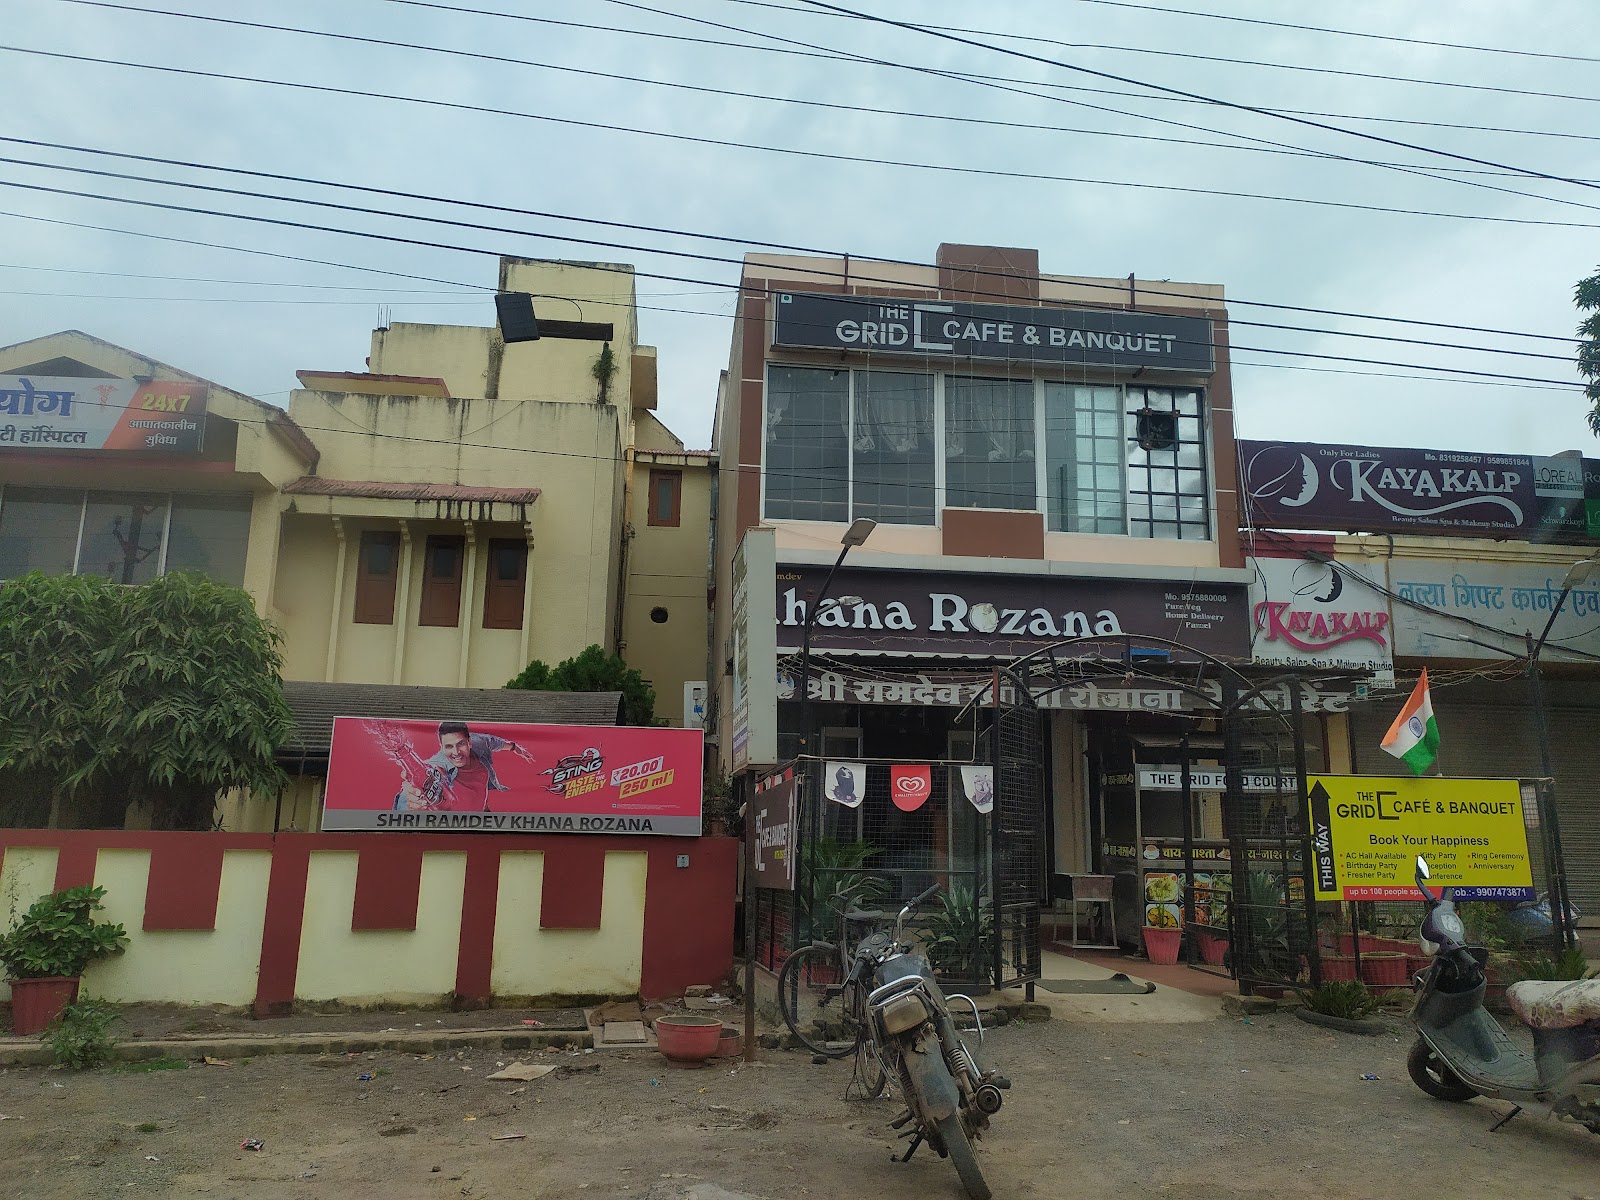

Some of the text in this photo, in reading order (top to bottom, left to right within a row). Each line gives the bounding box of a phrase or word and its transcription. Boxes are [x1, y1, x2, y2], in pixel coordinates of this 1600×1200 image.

[879, 304, 909, 320] THE
[836, 320, 909, 346] GRID
[1022, 325, 1041, 345] &
[1050, 327, 1177, 353] BANQUET
[142, 393, 191, 412] 24x7
[129, 419, 197, 431] आपातकालीन
[145, 433, 178, 447] सुविधा
[1320, 449, 1339, 458] Only
[1355, 451, 1381, 459] Ladies
[1330, 459, 1522, 508] KAYAKALP
[1392, 515, 1417, 524] Beauty
[1462, 520, 1491, 528] Makeup
[1165, 593, 1180, 601] Mo.
[777, 587, 917, 631] hana
[929, 593, 1126, 637] Rzana
[1186, 603, 1202, 612] Veg
[1191, 613, 1225, 622] Delivery
[1254, 602, 1390, 645] KAYAKALP
[1368, 661, 1393, 671] Studio
[853, 675, 962, 705] रामदेव
[553, 758, 603, 784] STING
[565, 774, 596, 790] TASTE
[622, 779, 649, 796] 250
[1150, 774, 1296, 788] THE RID FD COURT
[565, 779, 607, 799] ENERGY
[1357, 792, 1374, 801] THE
[1336, 799, 1515, 819] GRID CAFÉ & BANQUET
[376, 813, 654, 832] SHRI RAMDEV KHANA ROZANA
[1369, 834, 1489, 848] Book Your Happiness
[1317, 823, 1333, 888] THIS WAY
[1420, 852, 1437, 860] Kitty
[1438, 852, 1457, 860] Party
[1471, 852, 1488, 861] Ring
[1489, 853, 1525, 861] Ceremony
[1346, 862, 1515, 871] Birthday Party eception Anniversary
[1377, 872, 1396, 880] Party
[1428, 872, 1463, 880] onference
[1349, 888, 1359, 896] up
[1384, 888, 1408, 897] people
[1453, 887, 1475, 897] ob.:-
[1476, 887, 1527, 897] 9907473871
